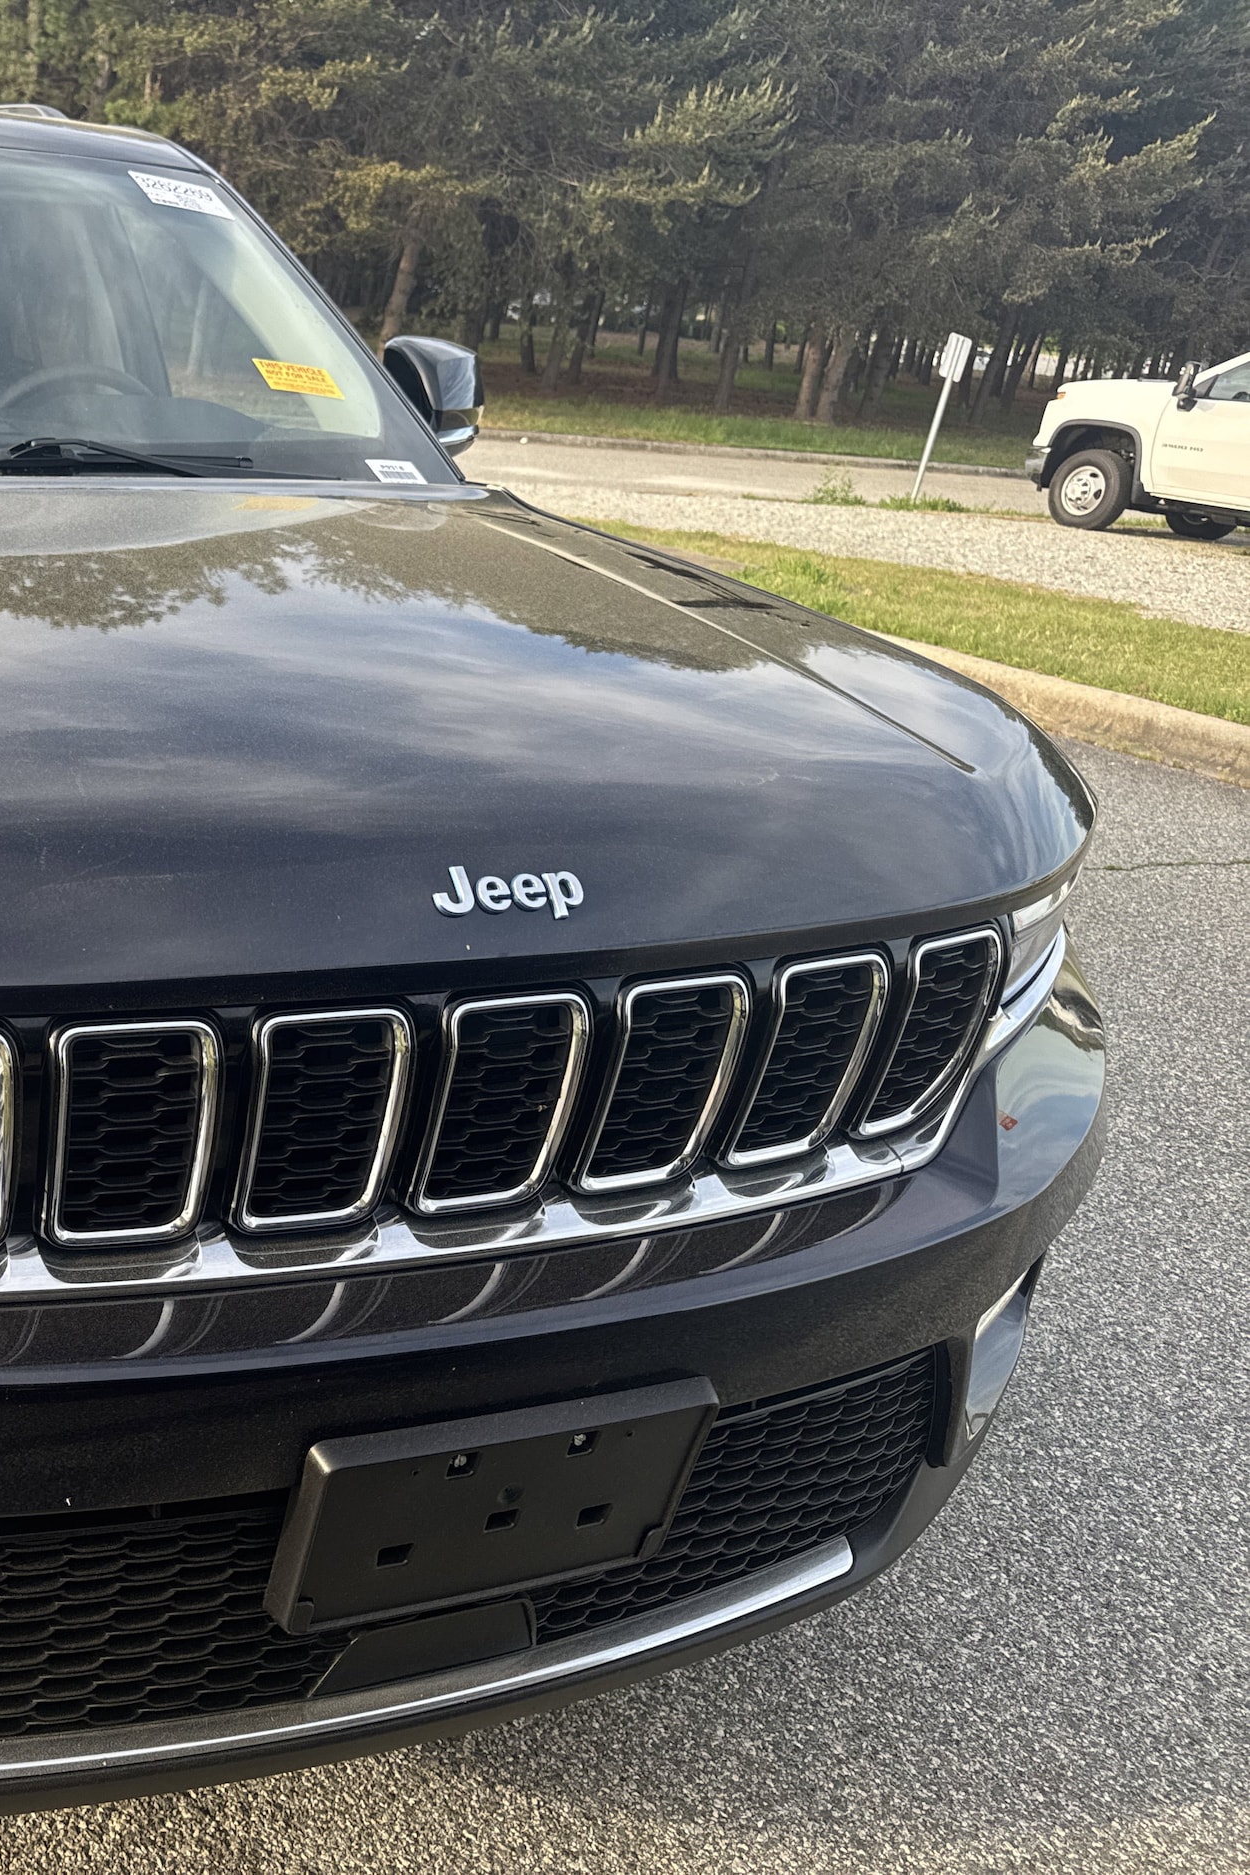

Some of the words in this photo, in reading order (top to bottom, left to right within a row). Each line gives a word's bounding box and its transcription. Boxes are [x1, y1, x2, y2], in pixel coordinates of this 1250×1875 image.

[258, 361, 283, 371] THIS
[283, 363, 326, 377] VEHICLE
[265, 369, 284, 377] NOT
[285, 371, 304, 379] FOR
[305, 374, 329, 384] SALE
[432, 865, 585, 920] Jeep
